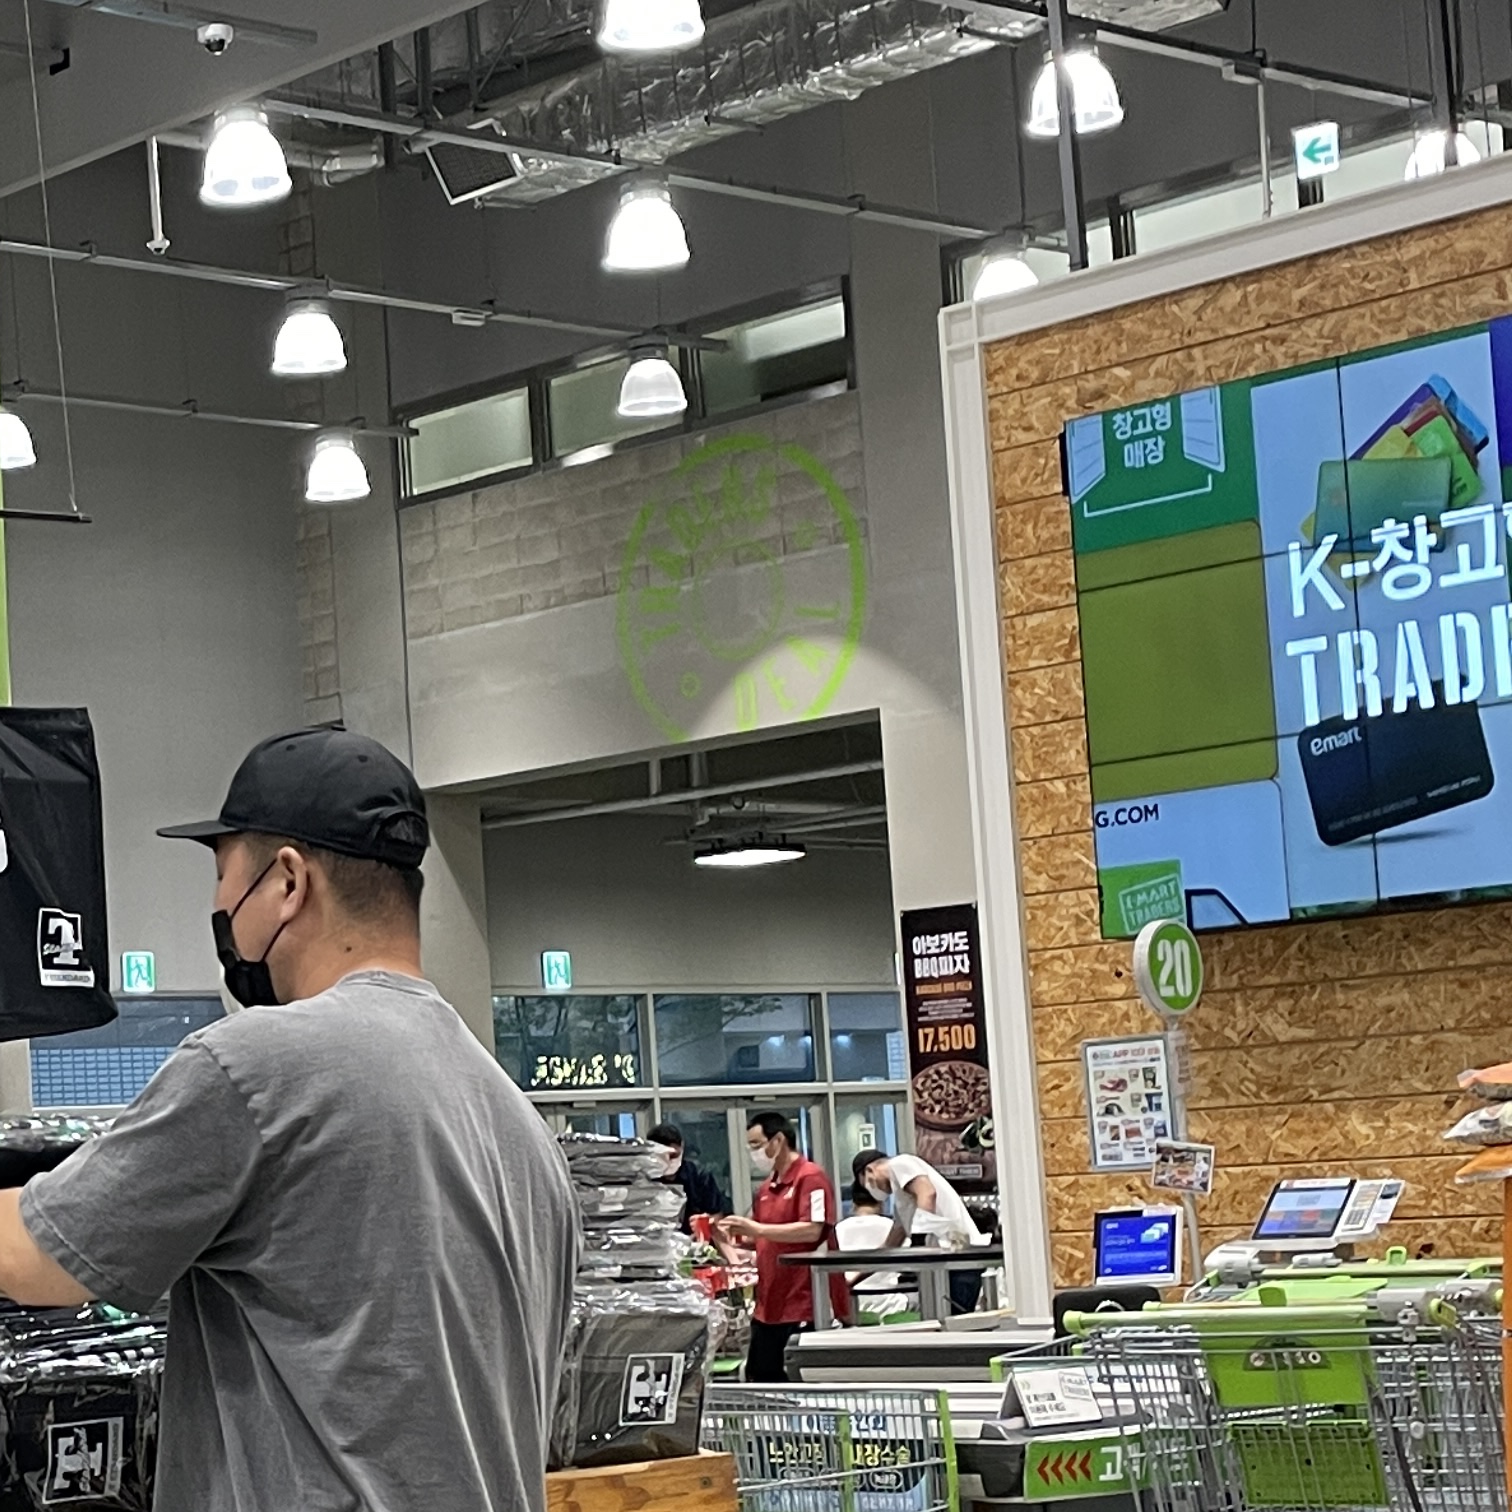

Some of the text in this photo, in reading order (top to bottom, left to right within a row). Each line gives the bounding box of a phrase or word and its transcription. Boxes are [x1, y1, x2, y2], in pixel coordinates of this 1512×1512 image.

[1112, 402, 1172, 440] 창고형
[1123, 437, 1166, 469] 매장
[1287, 502, 1512, 619] K-창고
[1310, 726, 1363, 757] emart
[912, 930, 970, 956] 아보카도
[914, 953, 971, 979] BBQ피자
[1157, 938, 1193, 998] 20
